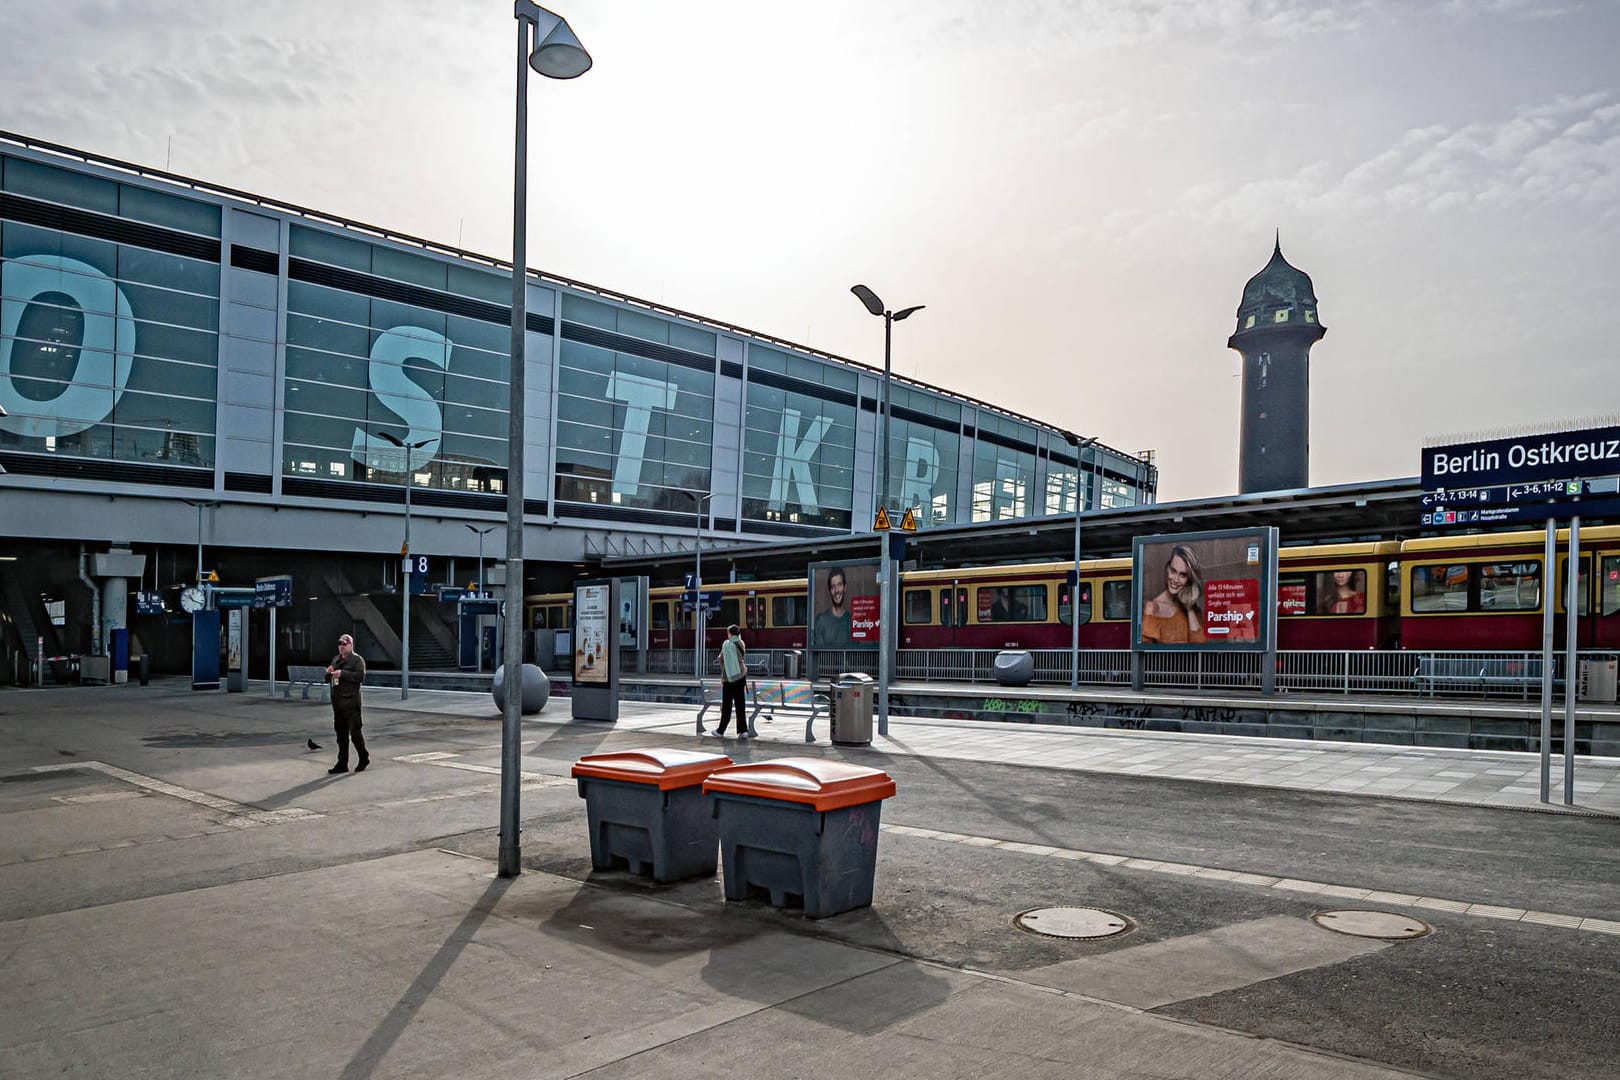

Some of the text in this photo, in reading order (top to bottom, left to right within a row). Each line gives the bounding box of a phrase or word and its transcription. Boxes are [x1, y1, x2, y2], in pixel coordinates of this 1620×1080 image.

[1433, 440, 1620, 475] Berlin Ostkreuz
[1523, 484, 1541, 494] 3-6,
[1543, 482, 1564, 492] 11-12
[1433, 490, 1477, 501] 1-2, 7, 13-14
[418, 556, 428, 573] 8
[687, 575, 693, 587] 7
[1207, 610, 1244, 624] Parship
[852, 619, 874, 630] Parship
